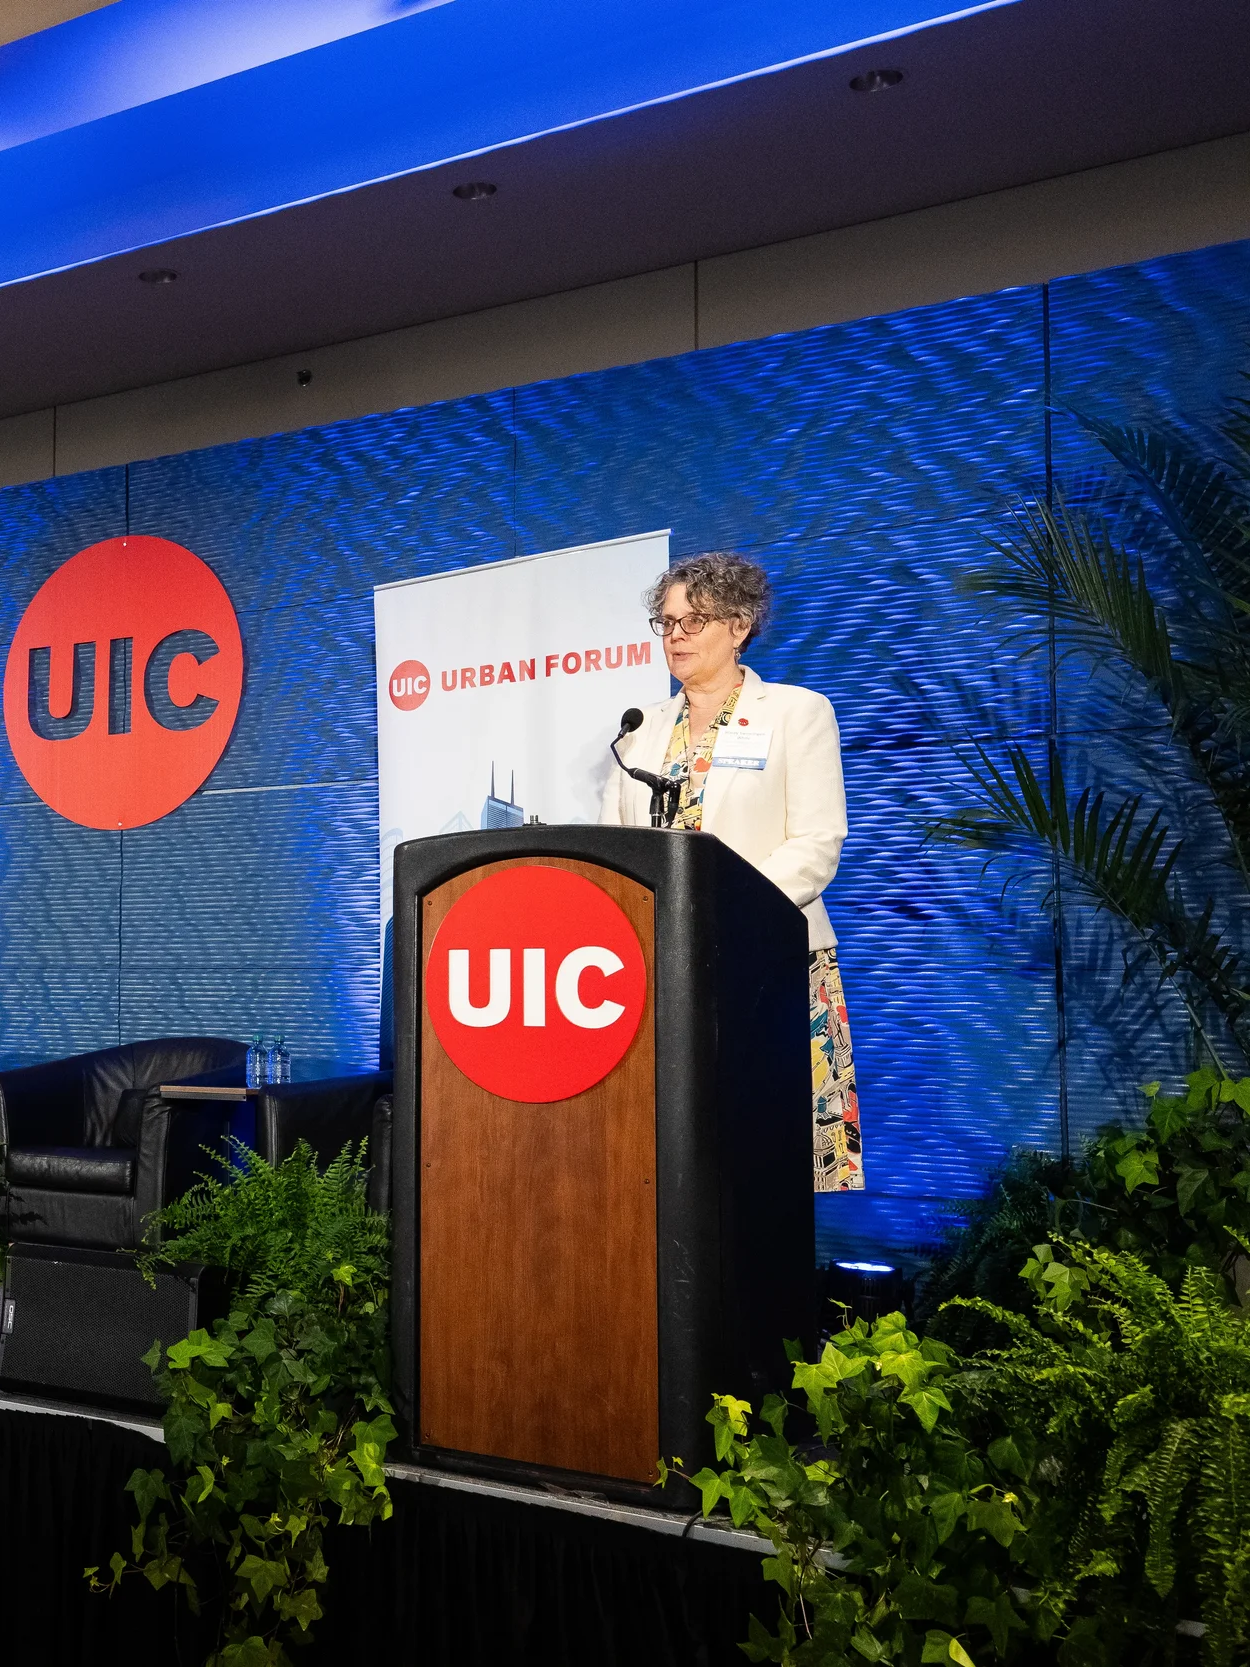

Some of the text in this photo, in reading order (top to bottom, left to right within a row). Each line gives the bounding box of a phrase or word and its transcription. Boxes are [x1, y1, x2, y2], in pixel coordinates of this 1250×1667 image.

[28, 629, 220, 741] UIC
[392, 641, 651, 697] UIC URBAN FORUM
[448, 946, 626, 1029] UIC
